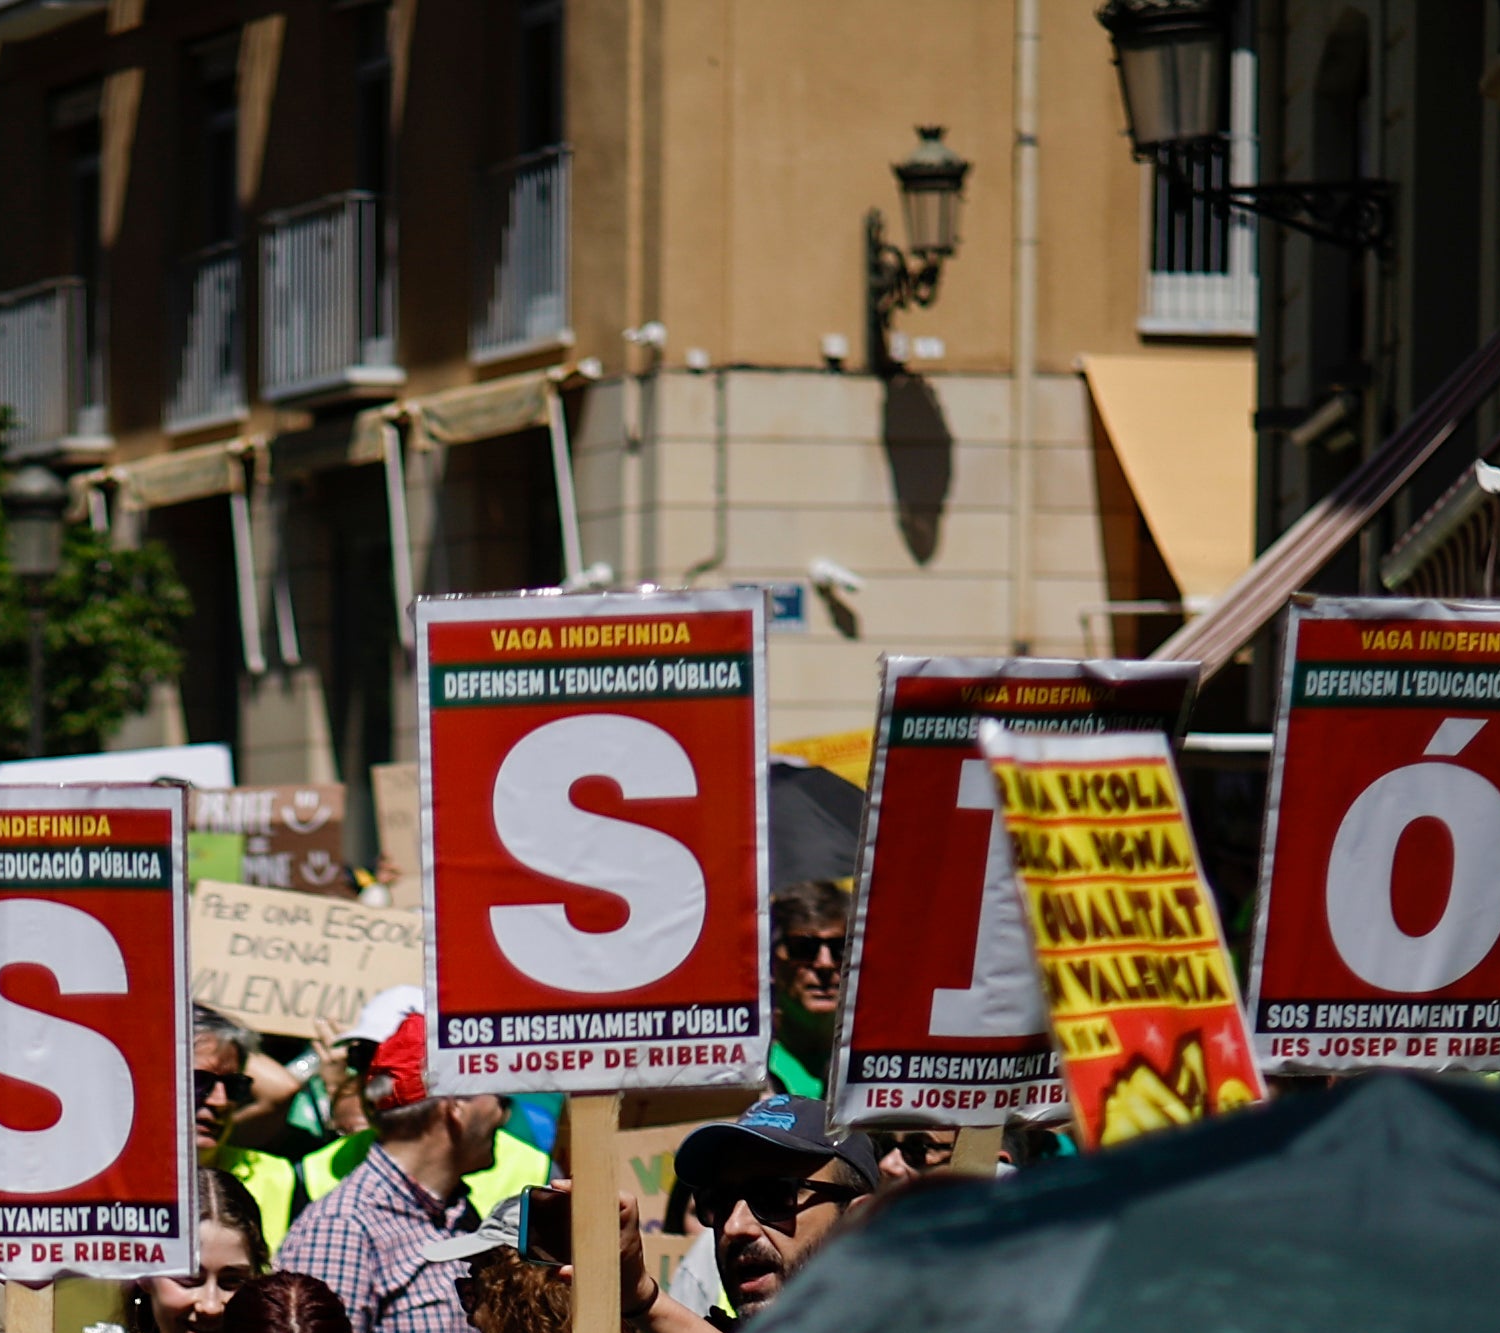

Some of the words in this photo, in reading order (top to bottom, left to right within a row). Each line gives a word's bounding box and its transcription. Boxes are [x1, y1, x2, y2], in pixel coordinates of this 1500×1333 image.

[491, 627, 553, 650] VAGA
[560, 622, 690, 647] INDEFINIDA
[1362, 630, 1413, 649] VAGA
[444, 669, 544, 698] DEFENSEM
[549, 660, 658, 694] L'EDUCACIÓ
[662, 659, 740, 690] PÚBLICA
[1304, 670, 1397, 696] DEFENSEM
[961, 685, 1009, 705] VAGA
[1015, 685, 1118, 705] INDEFINIDA
[902, 716, 978, 740] DEFENSE
[88, 848, 160, 879] PÚBLICA
[489, 714, 706, 994] S
[202, 892, 249, 922] PER
[229, 932, 330, 966] DIGNA
[448, 1017, 493, 1044] SOS
[500, 1011, 665, 1042] ENSENYAMENT
[672, 1006, 748, 1035] PÚBLIC
[1267, 1004, 1309, 1027] SOS
[1315, 1004, 1468, 1027] ENSENYAMENT
[458, 1053, 498, 1074] IES
[508, 1050, 593, 1072] JOSEP
[604, 1048, 637, 1068] DE
[648, 1043, 746, 1066] RIBERA
[1271, 1037, 1309, 1056] IES
[1318, 1037, 1397, 1056] JOSEP
[1405, 1037, 1437, 1056] DE
[862, 1055, 901, 1078] SOS
[908, 1053, 1043, 1079] ENSENYAMENT
[866, 1088, 902, 1109] IES
[910, 1088, 986, 1109] JOSEP
[993, 1087, 1021, 1108] DE
[96, 1201, 169, 1232] PÚBLIC
[31, 1243, 63, 1262] DE
[74, 1241, 164, 1262] RIBERA
